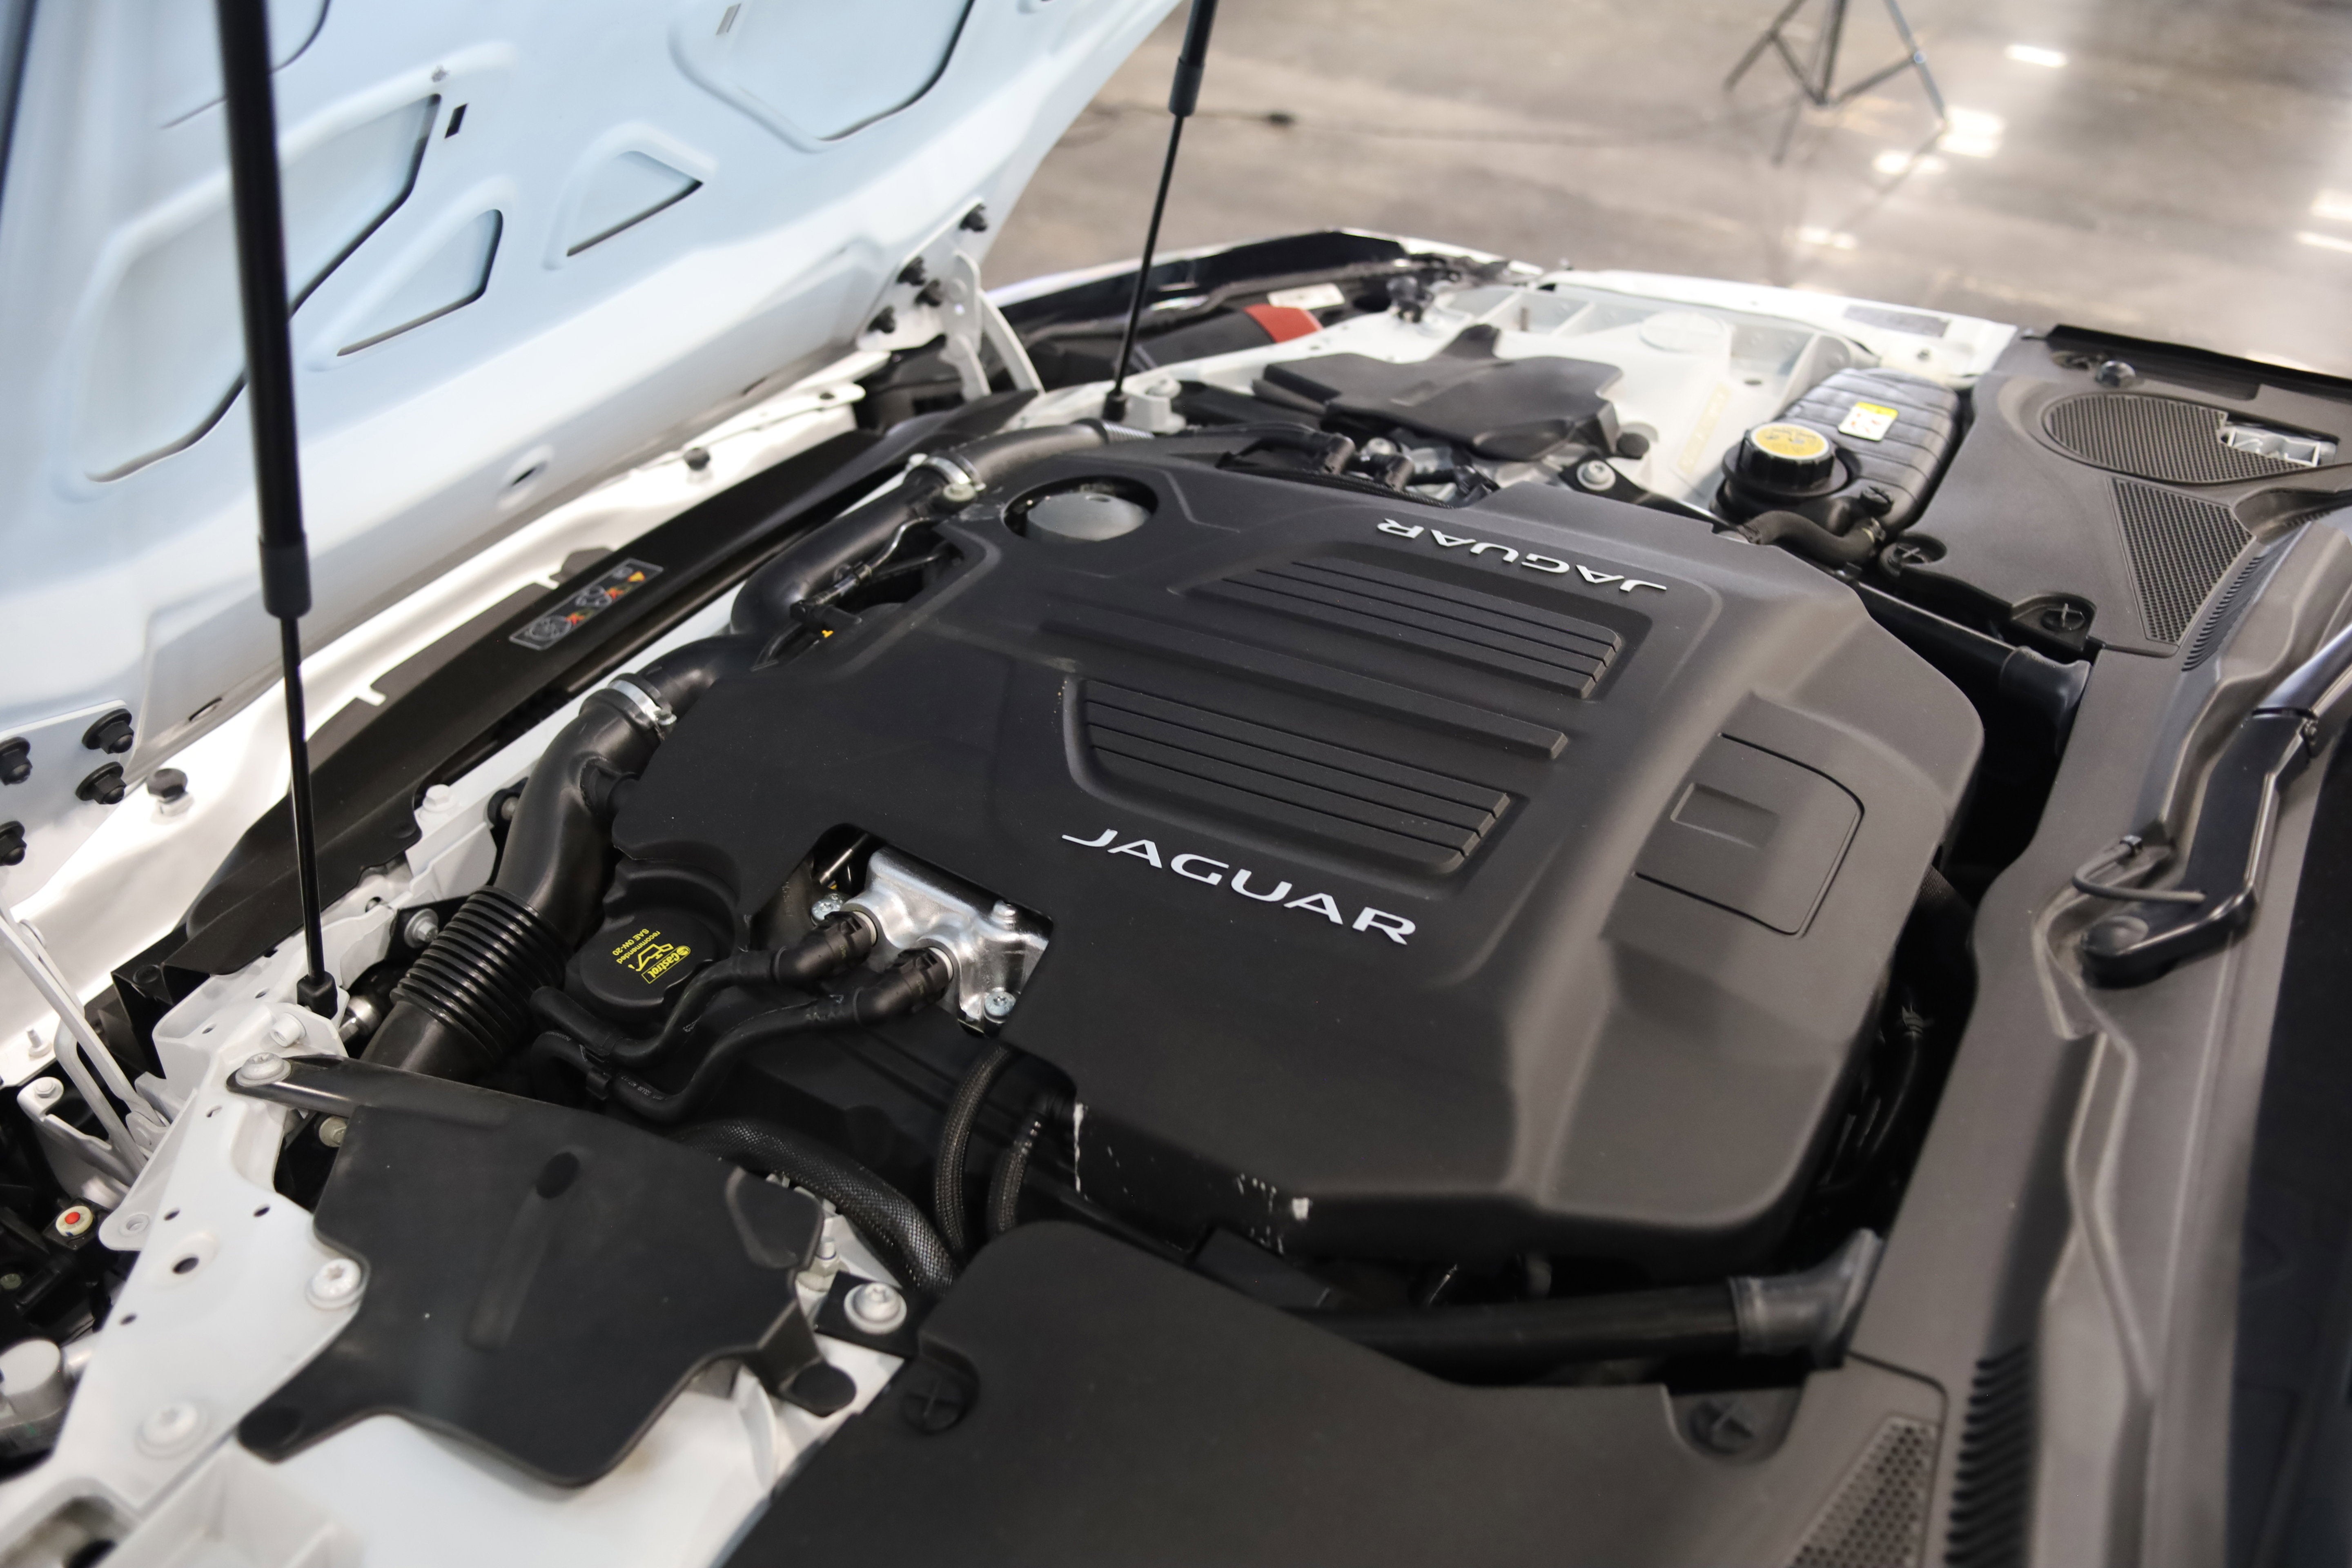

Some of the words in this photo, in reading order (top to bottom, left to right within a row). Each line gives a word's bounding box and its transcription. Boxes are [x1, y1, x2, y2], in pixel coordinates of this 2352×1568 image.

[1376, 518, 1667, 592] JAGUAR
[1062, 829, 1416, 945] JAGUAR
[612, 939, 635, 956] 0W-20
[616, 931, 661, 964] recommended
[633, 929, 650, 941] SAE
[647, 952, 680, 978] Castrol
